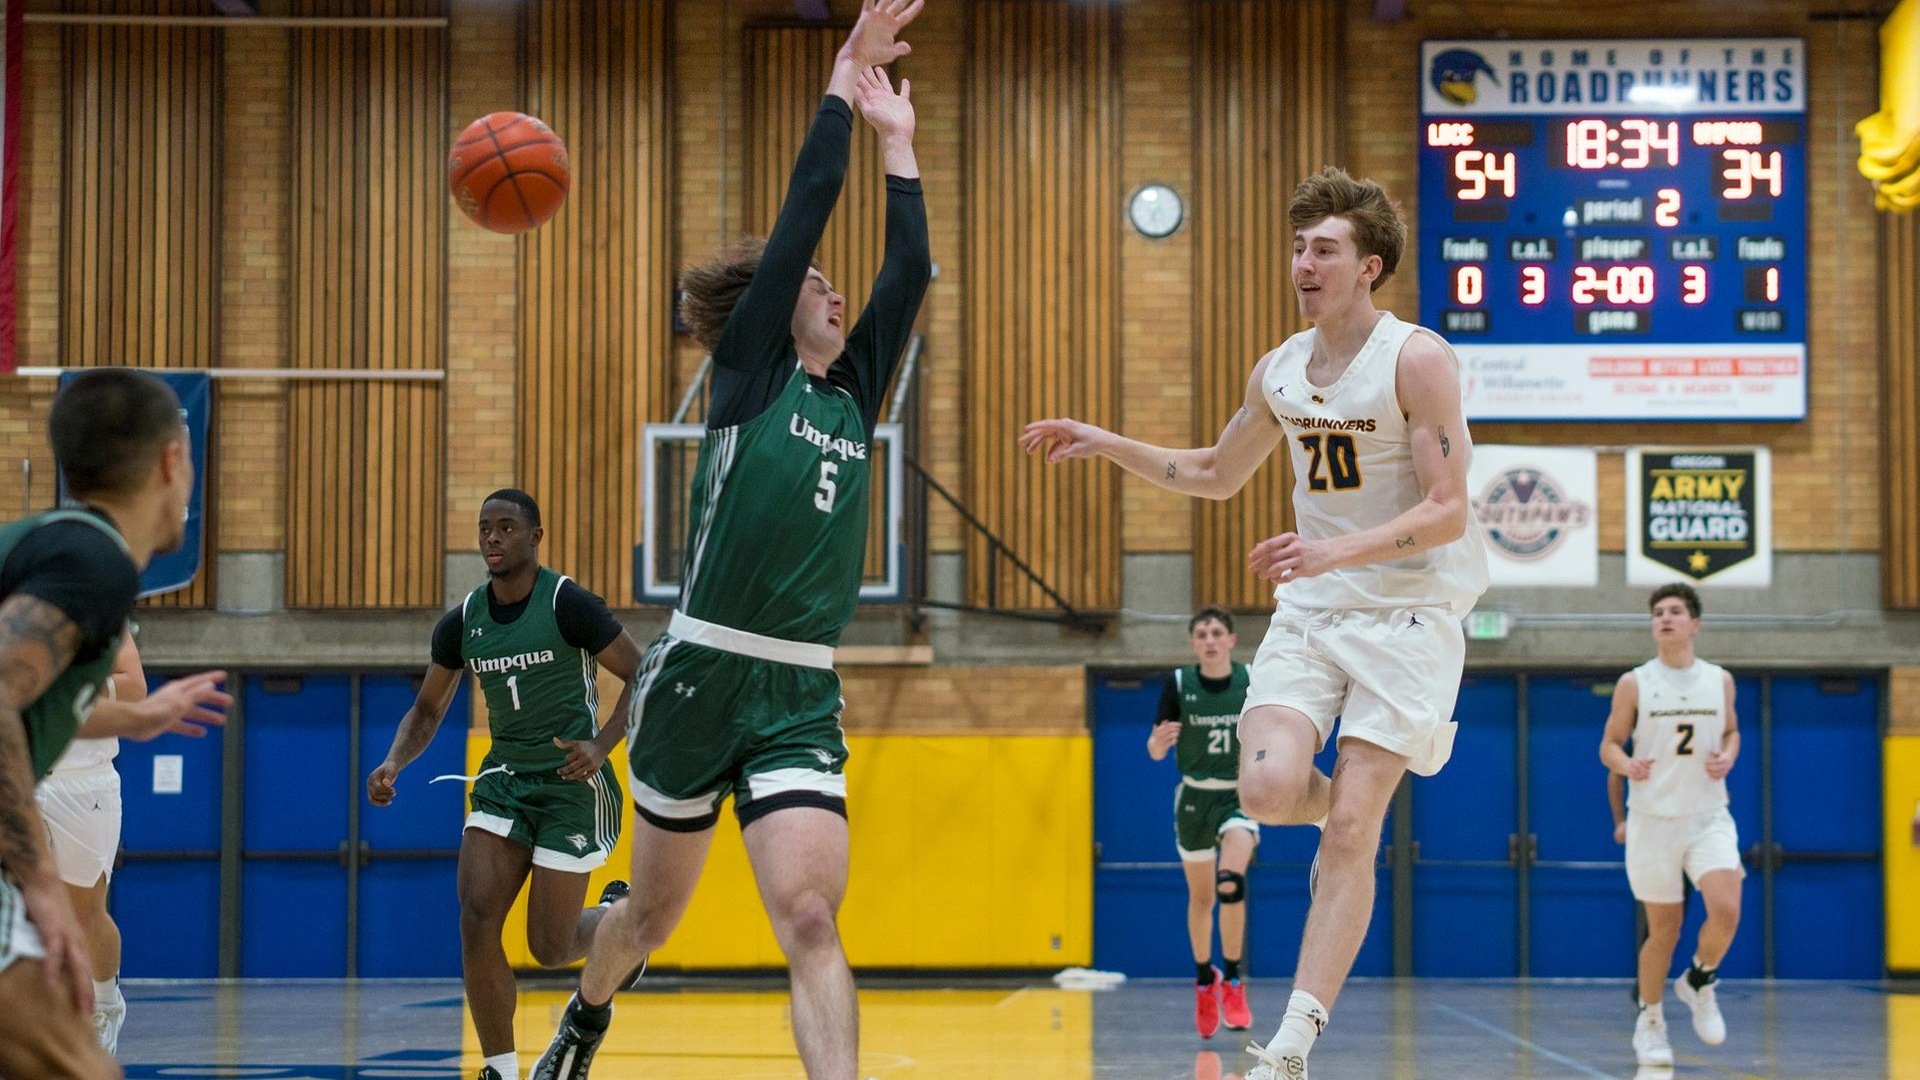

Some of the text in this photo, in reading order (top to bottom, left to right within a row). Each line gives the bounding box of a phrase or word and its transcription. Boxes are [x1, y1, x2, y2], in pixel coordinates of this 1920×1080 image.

[1508, 48, 1792, 66] HOME OF THE
[1566, 119, 1678, 169] 18:34
[1455, 150, 1515, 200] 54
[1723, 149, 1781, 198] 34
[1584, 197, 1642, 225] period
[1655, 188, 1680, 226] 2
[1443, 237, 1488, 260] fouls
[1582, 236, 1644, 260] player
[1738, 236, 1784, 260] fouls
[1457, 266, 1482, 304] 0
[1522, 266, 1545, 304] 3
[1683, 266, 1706, 304] 3
[1766, 267, 1778, 302] 1
[1446, 312, 1485, 331] won
[1588, 311, 1638, 334] game
[1742, 312, 1781, 331] won
[1280, 413, 1377, 432] DRUNNERS
[789, 412, 866, 461] Umpqua
[1297, 431, 1363, 493] 20
[814, 460, 838, 513] 5
[1650, 475, 1745, 500] ARMY
[1650, 500, 1746, 516] NATIONAL
[1649, 516, 1748, 540] GUARD
[469, 649, 555, 674] Umpqua
[506, 675, 520, 711] 1
[1189, 714, 1240, 727] Umpqu
[1207, 728, 1231, 754] 21
[1676, 723, 1695, 756] 2
